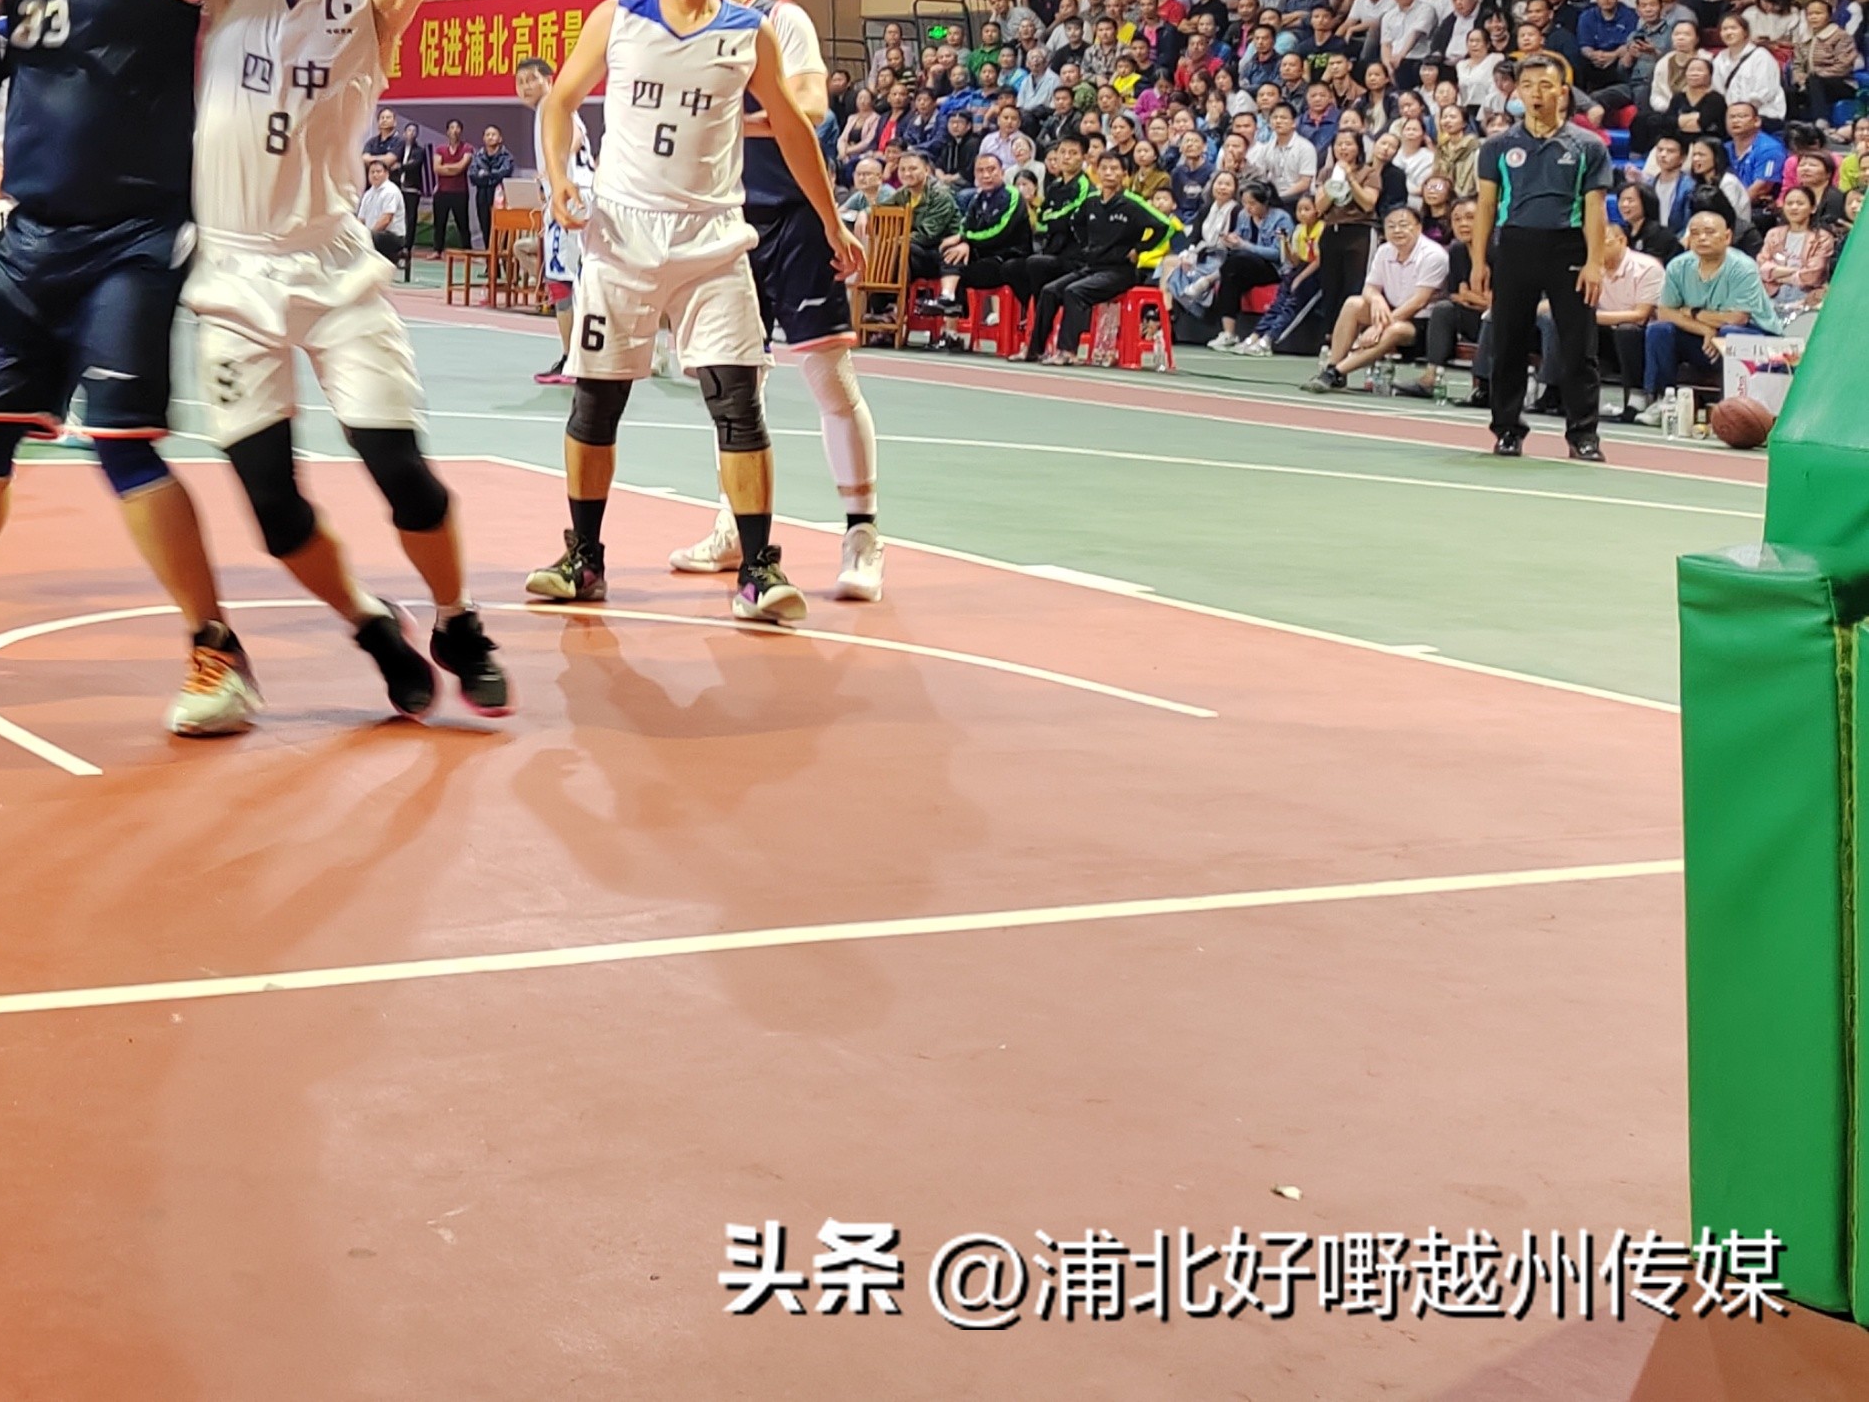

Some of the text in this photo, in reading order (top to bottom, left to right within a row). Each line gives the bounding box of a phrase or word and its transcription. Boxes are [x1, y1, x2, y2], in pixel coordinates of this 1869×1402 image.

[241, 52, 331, 100] 四中
[632, 80, 713, 117] 四中
[265, 111, 290, 156] 8
[653, 123, 678, 157] 6
[580, 313, 607, 352] 6
